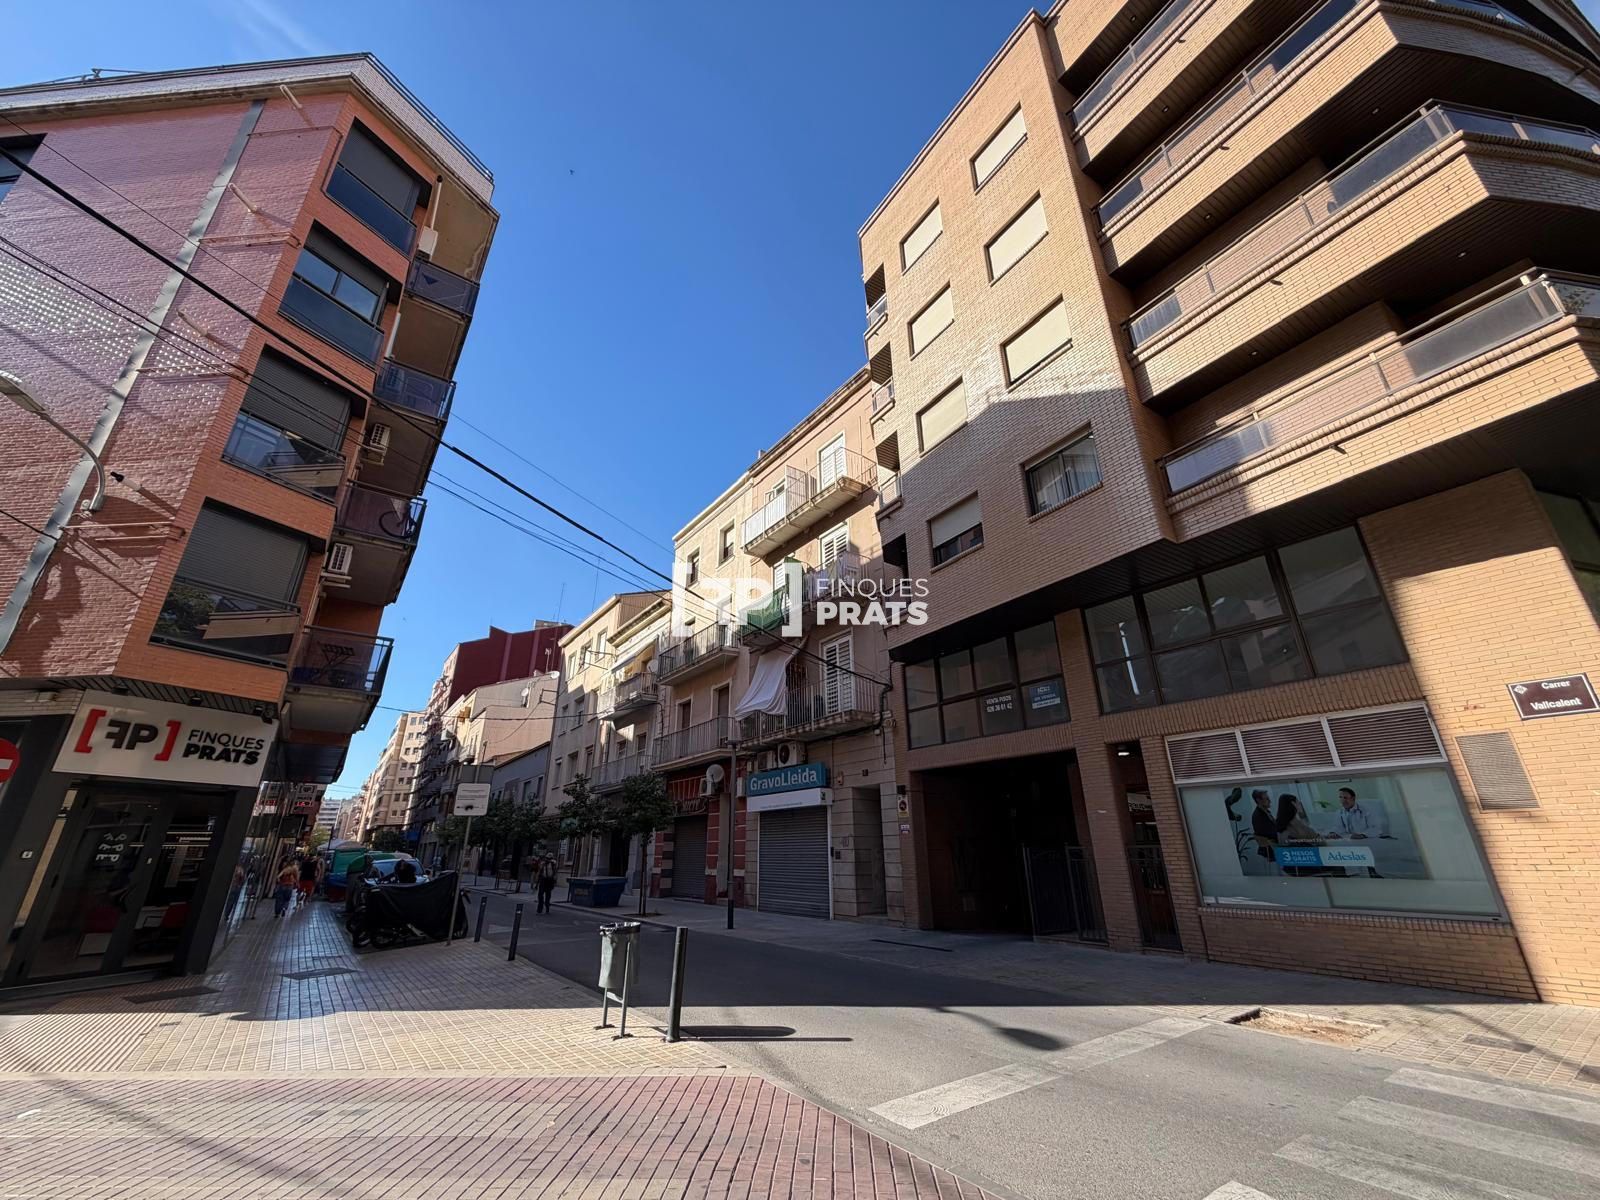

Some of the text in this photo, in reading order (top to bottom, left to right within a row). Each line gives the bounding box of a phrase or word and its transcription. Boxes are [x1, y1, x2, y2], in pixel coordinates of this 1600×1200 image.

[1541, 680, 1571, 690] Carrer
[1530, 697, 1582, 711] Vallcalent
[188, 729, 265, 751] FINQUES
[183, 745, 261, 766] PRATS
[750, 766, 817, 791] GravoLleida
[1282, 851, 1291, 861] 3
[1327, 850, 1367, 862] Adeslas
